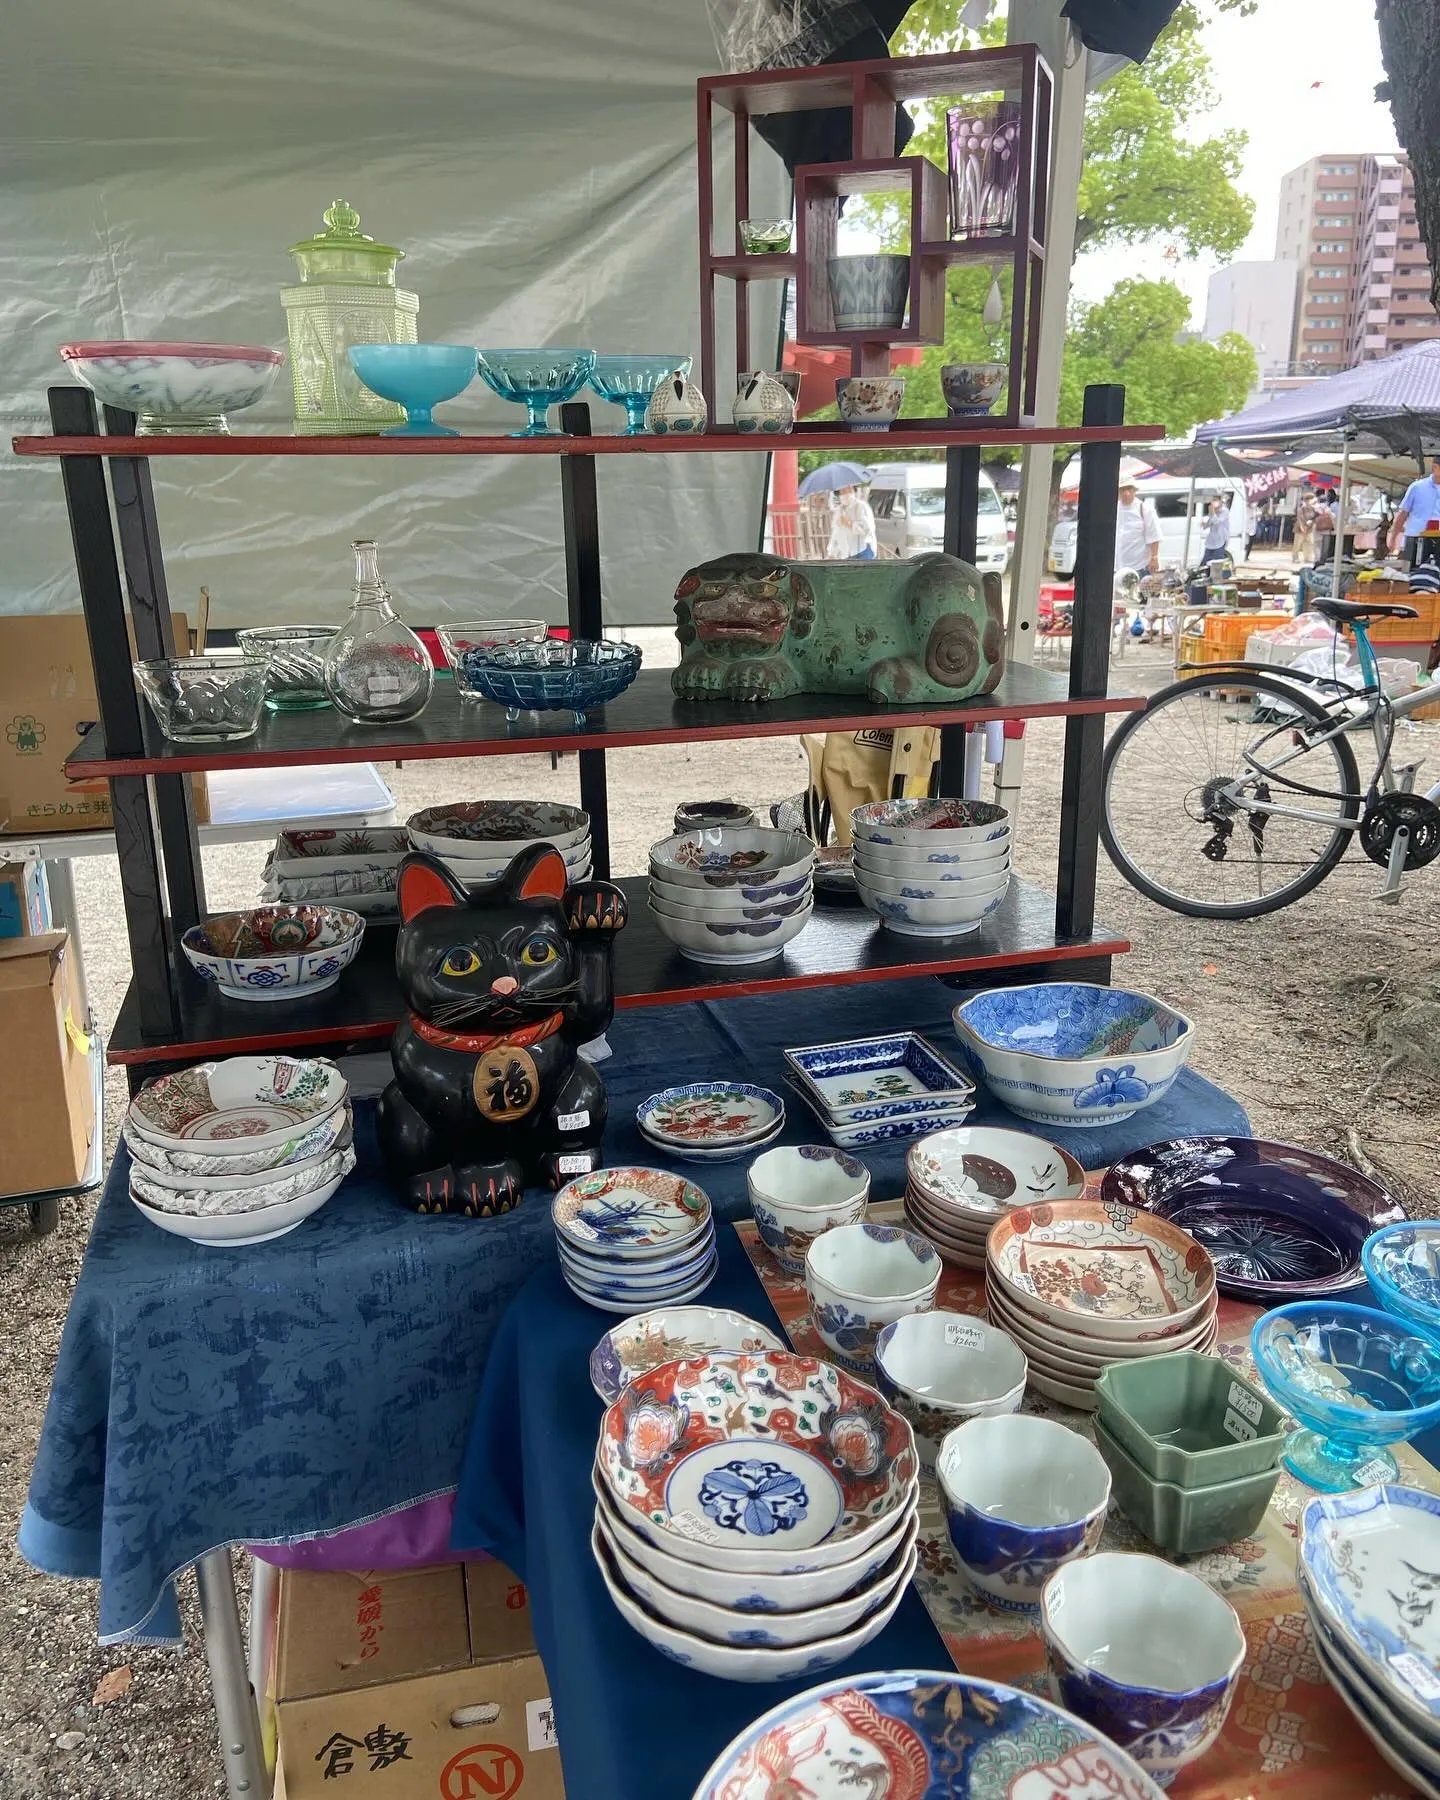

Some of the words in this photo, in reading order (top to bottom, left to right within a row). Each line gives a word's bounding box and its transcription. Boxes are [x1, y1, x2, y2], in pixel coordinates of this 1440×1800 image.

[26, 801, 112, 817] きらめき発
[486, 1060, 532, 1111] 福
[314, 1723, 413, 1780] 倉敷
